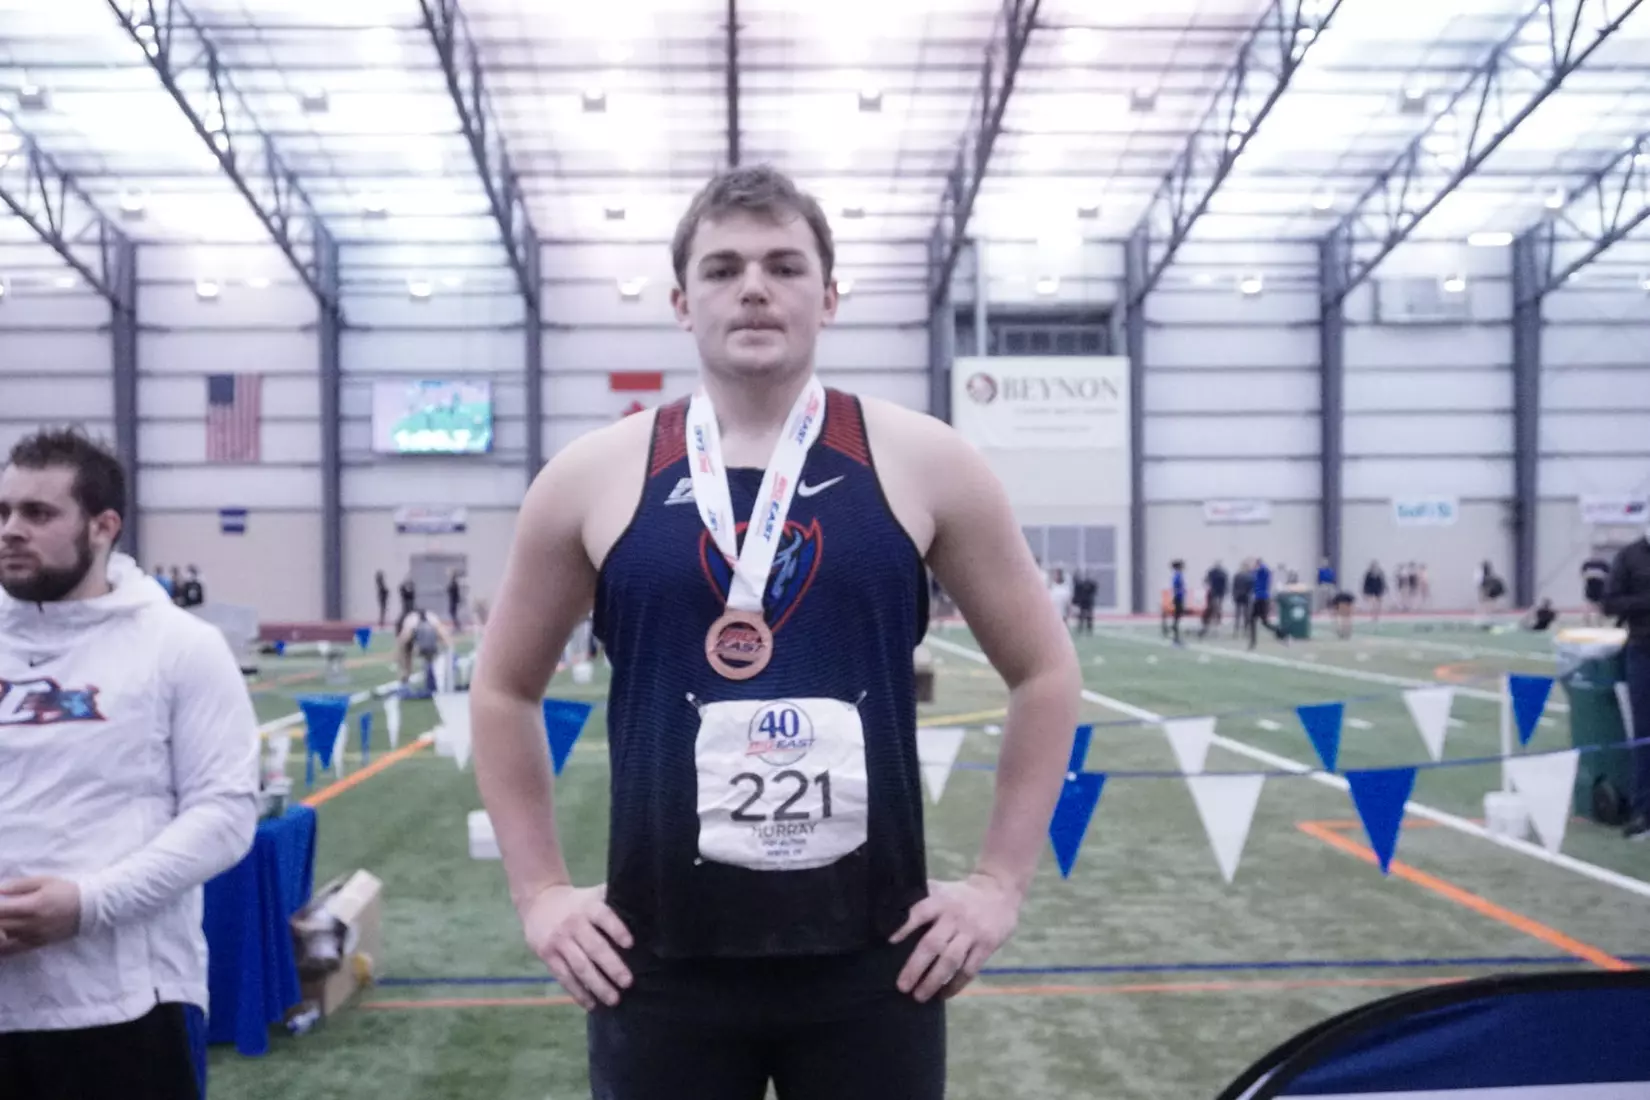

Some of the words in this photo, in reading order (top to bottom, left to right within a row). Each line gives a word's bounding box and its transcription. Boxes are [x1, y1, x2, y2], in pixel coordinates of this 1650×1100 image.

[1002, 376, 1119, 400] BEYNON
[758, 708, 800, 739] 40
[729, 769, 832, 822] 221
